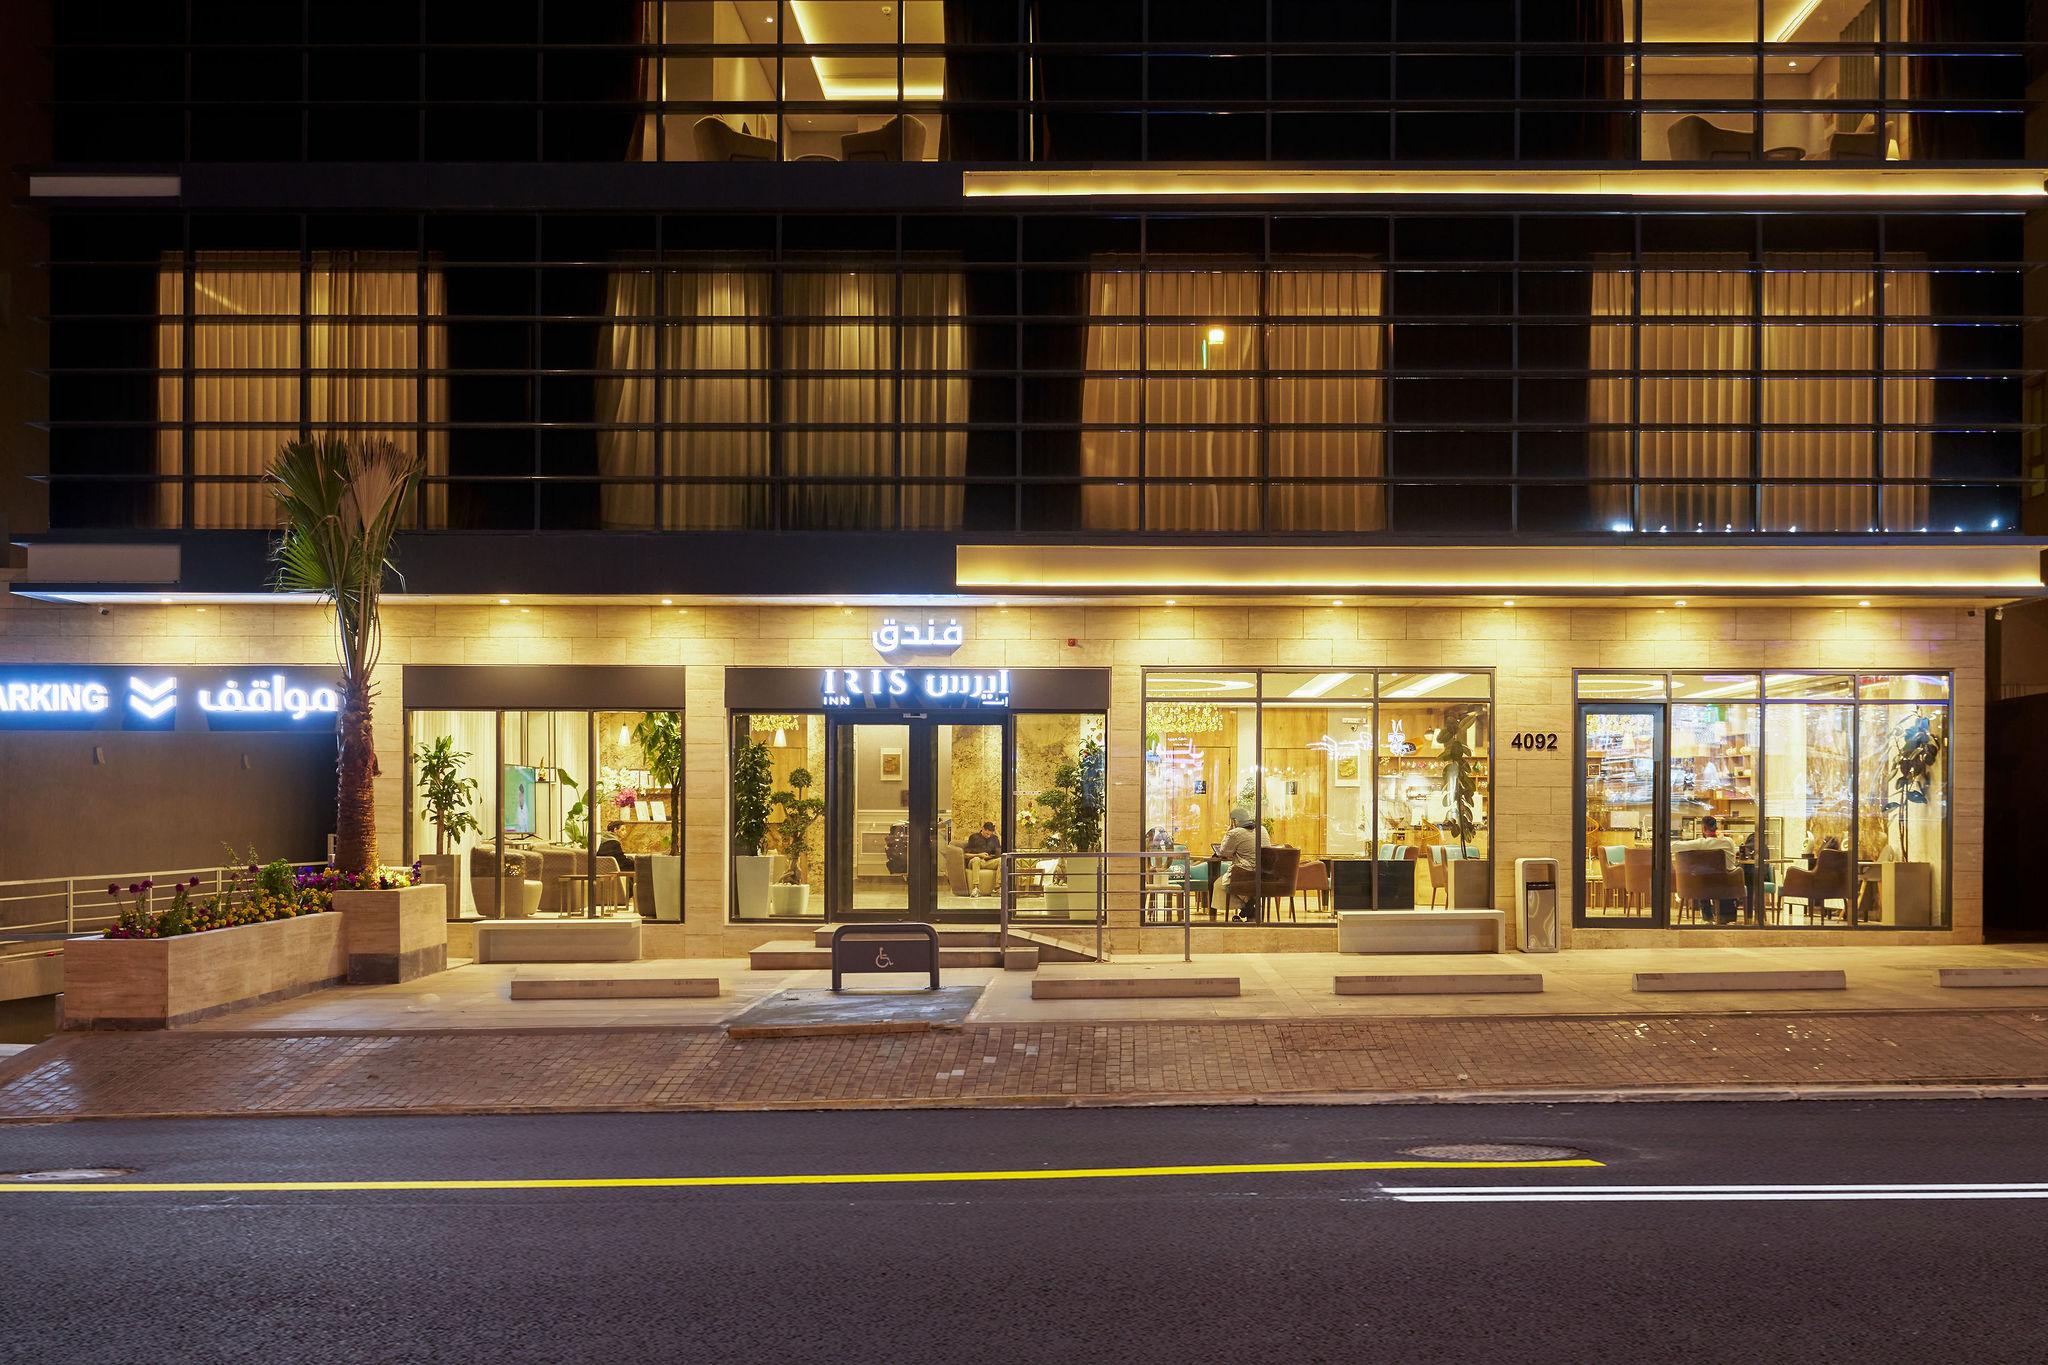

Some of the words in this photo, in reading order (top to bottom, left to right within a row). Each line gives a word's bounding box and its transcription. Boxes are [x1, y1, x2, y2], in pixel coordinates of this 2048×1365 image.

[871, 617, 963, 653] فندق
[823, 669, 908, 695] IRIS
[198, 674, 339, 720] مواقف
[823, 696, 851, 706] INN
[1511, 732, 1558, 750] 4092
